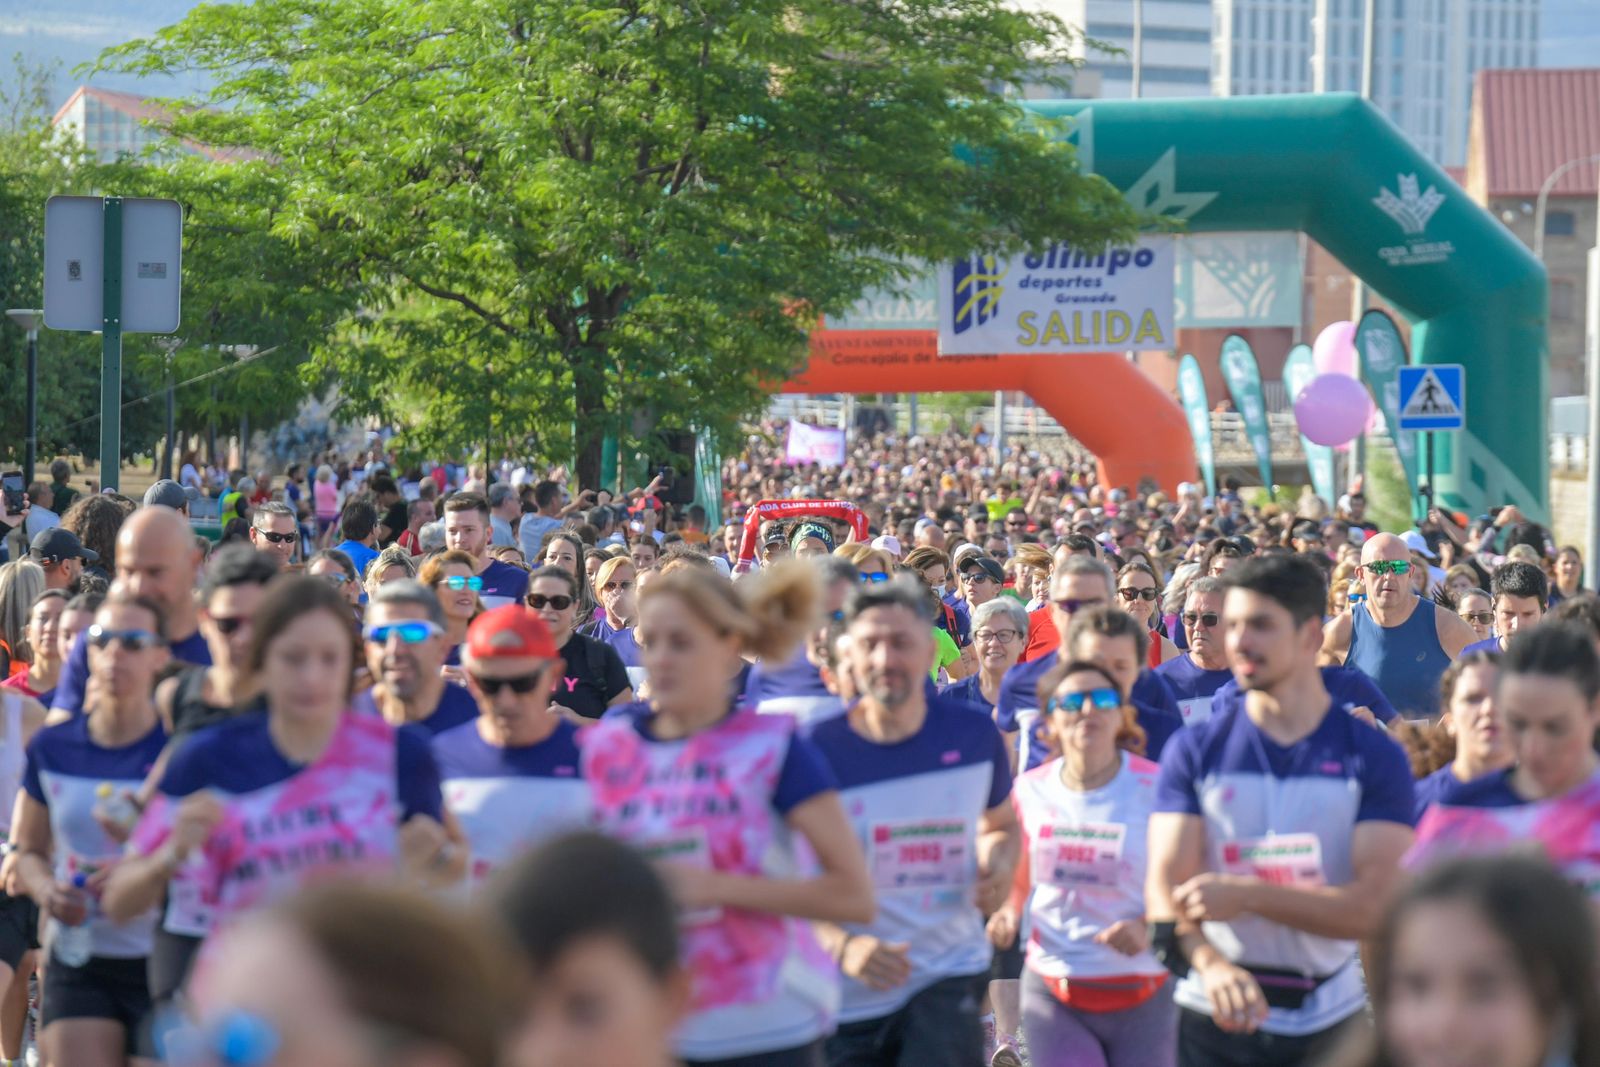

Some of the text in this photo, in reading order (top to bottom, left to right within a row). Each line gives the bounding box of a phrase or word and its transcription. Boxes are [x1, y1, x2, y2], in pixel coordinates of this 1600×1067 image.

[1024, 240, 1155, 275] olimpo
[1019, 275, 1103, 291] deportes
[1017, 308, 1165, 346] SALIDA
[781, 502, 806, 510] CLUB
